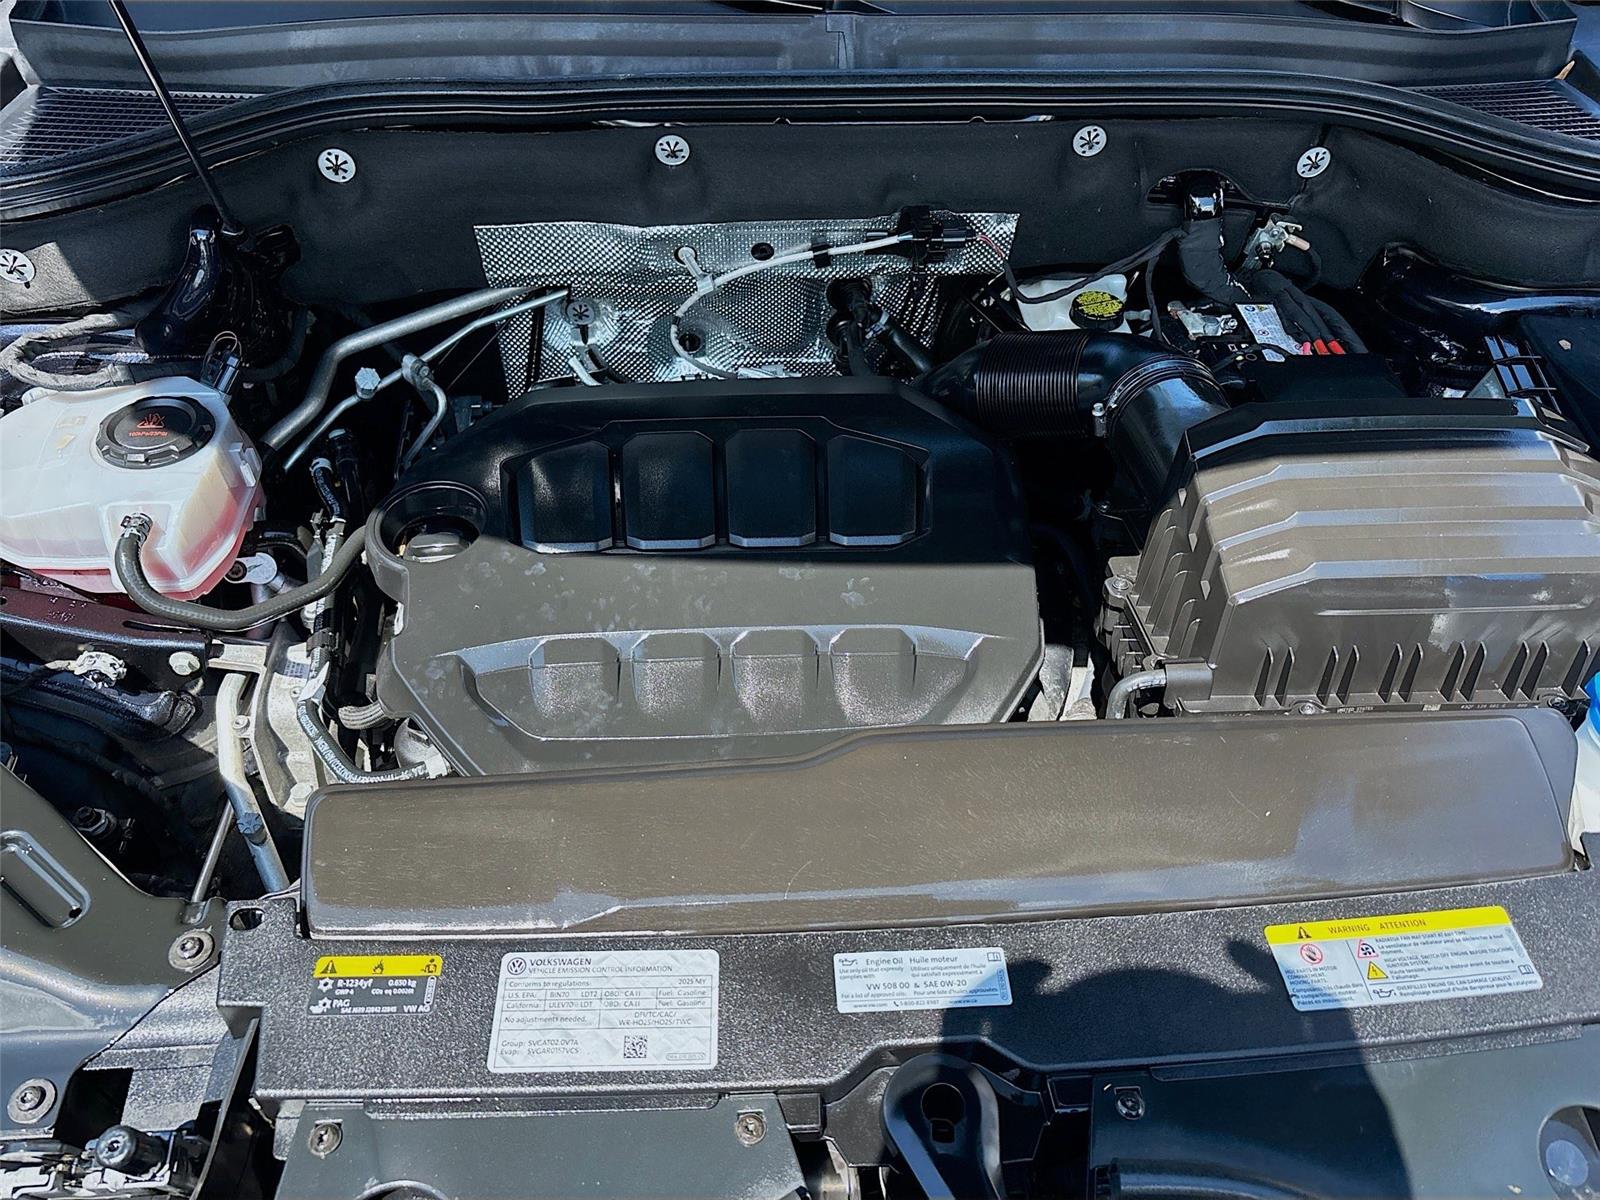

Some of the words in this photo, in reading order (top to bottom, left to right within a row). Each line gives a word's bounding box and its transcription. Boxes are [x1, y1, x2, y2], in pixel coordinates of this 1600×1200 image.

[1328, 924, 1370, 934] WARNING
[1380, 919, 1426, 929] ATTENTION
[892, 957, 904, 965] Oil
[336, 979, 374, 990] R-1234yf
[408, 979, 416, 988] kg
[940, 980, 966, 988] 0W-20
[332, 999, 350, 1008] PAG
[418, 1004, 431, 1012] AG
[516, 1016, 559, 1024] adjustments
